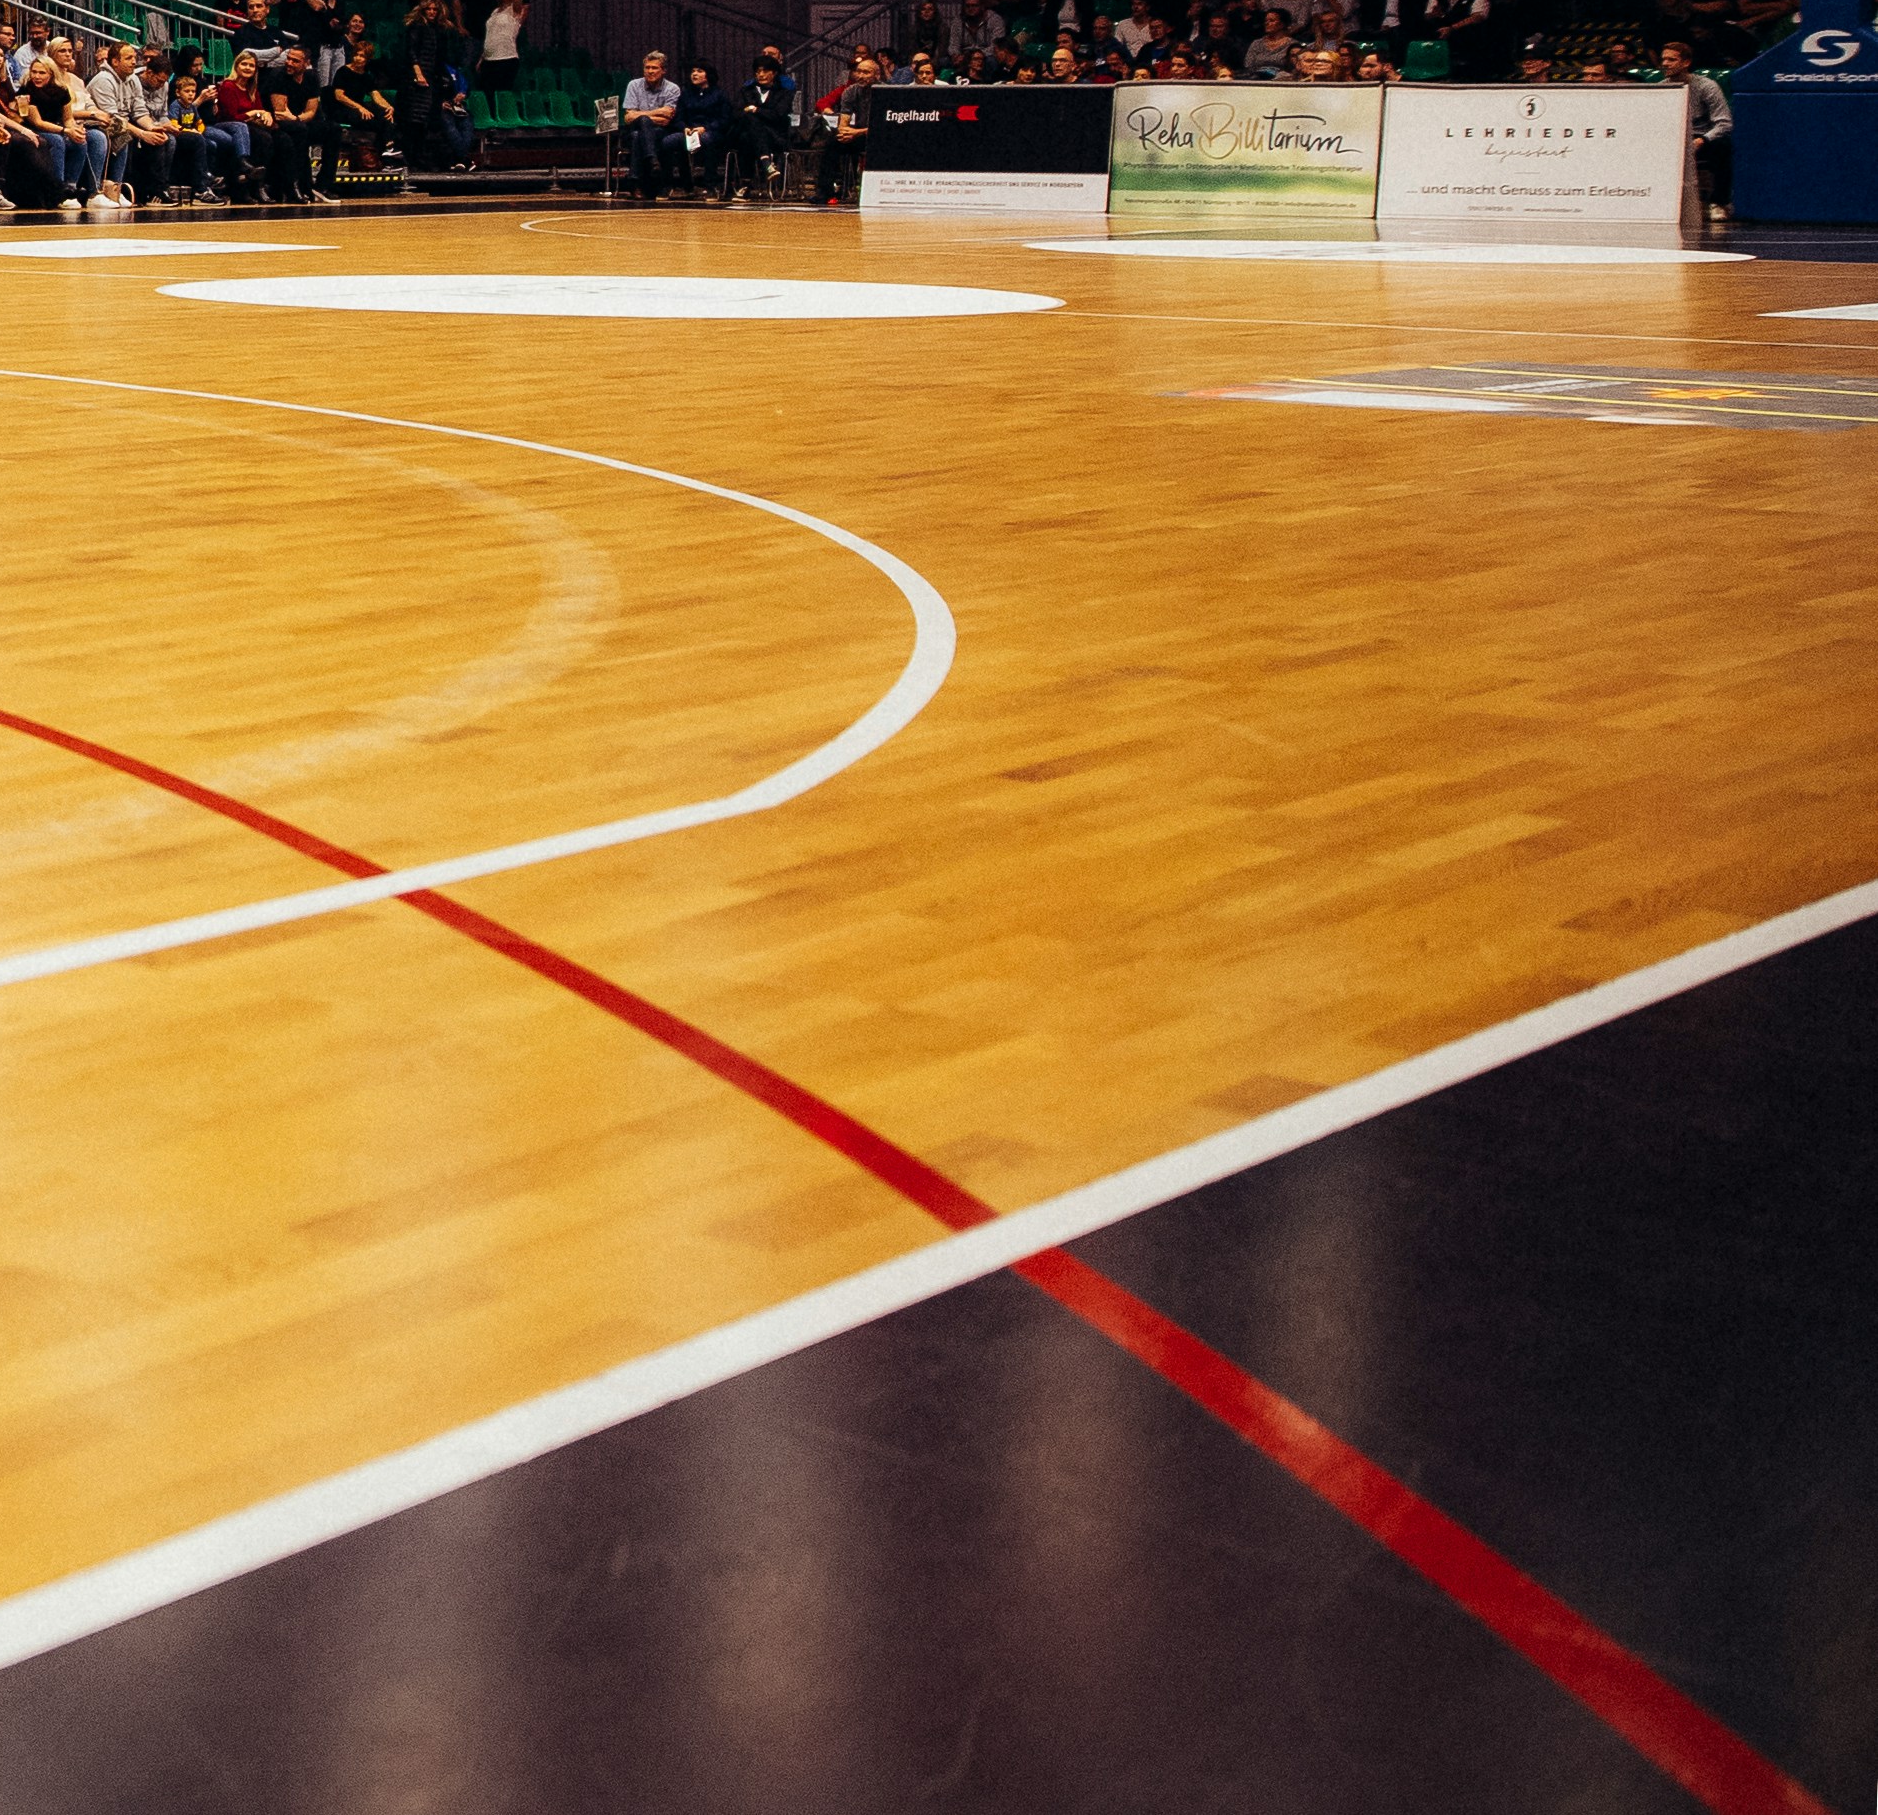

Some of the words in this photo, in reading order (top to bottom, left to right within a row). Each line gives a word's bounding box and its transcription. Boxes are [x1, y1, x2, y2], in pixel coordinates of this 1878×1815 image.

[885, 109, 940, 124] Engelhardt
[1445, 127, 1617, 139] LEHRIEDER
[1421, 184, 1449, 195] und
[1452, 184, 1496, 196] macht
[1500, 185, 1552, 197] Genuss
[1554, 187, 1585, 197] zum
[1589, 186, 1651, 198] Erlebnis!
